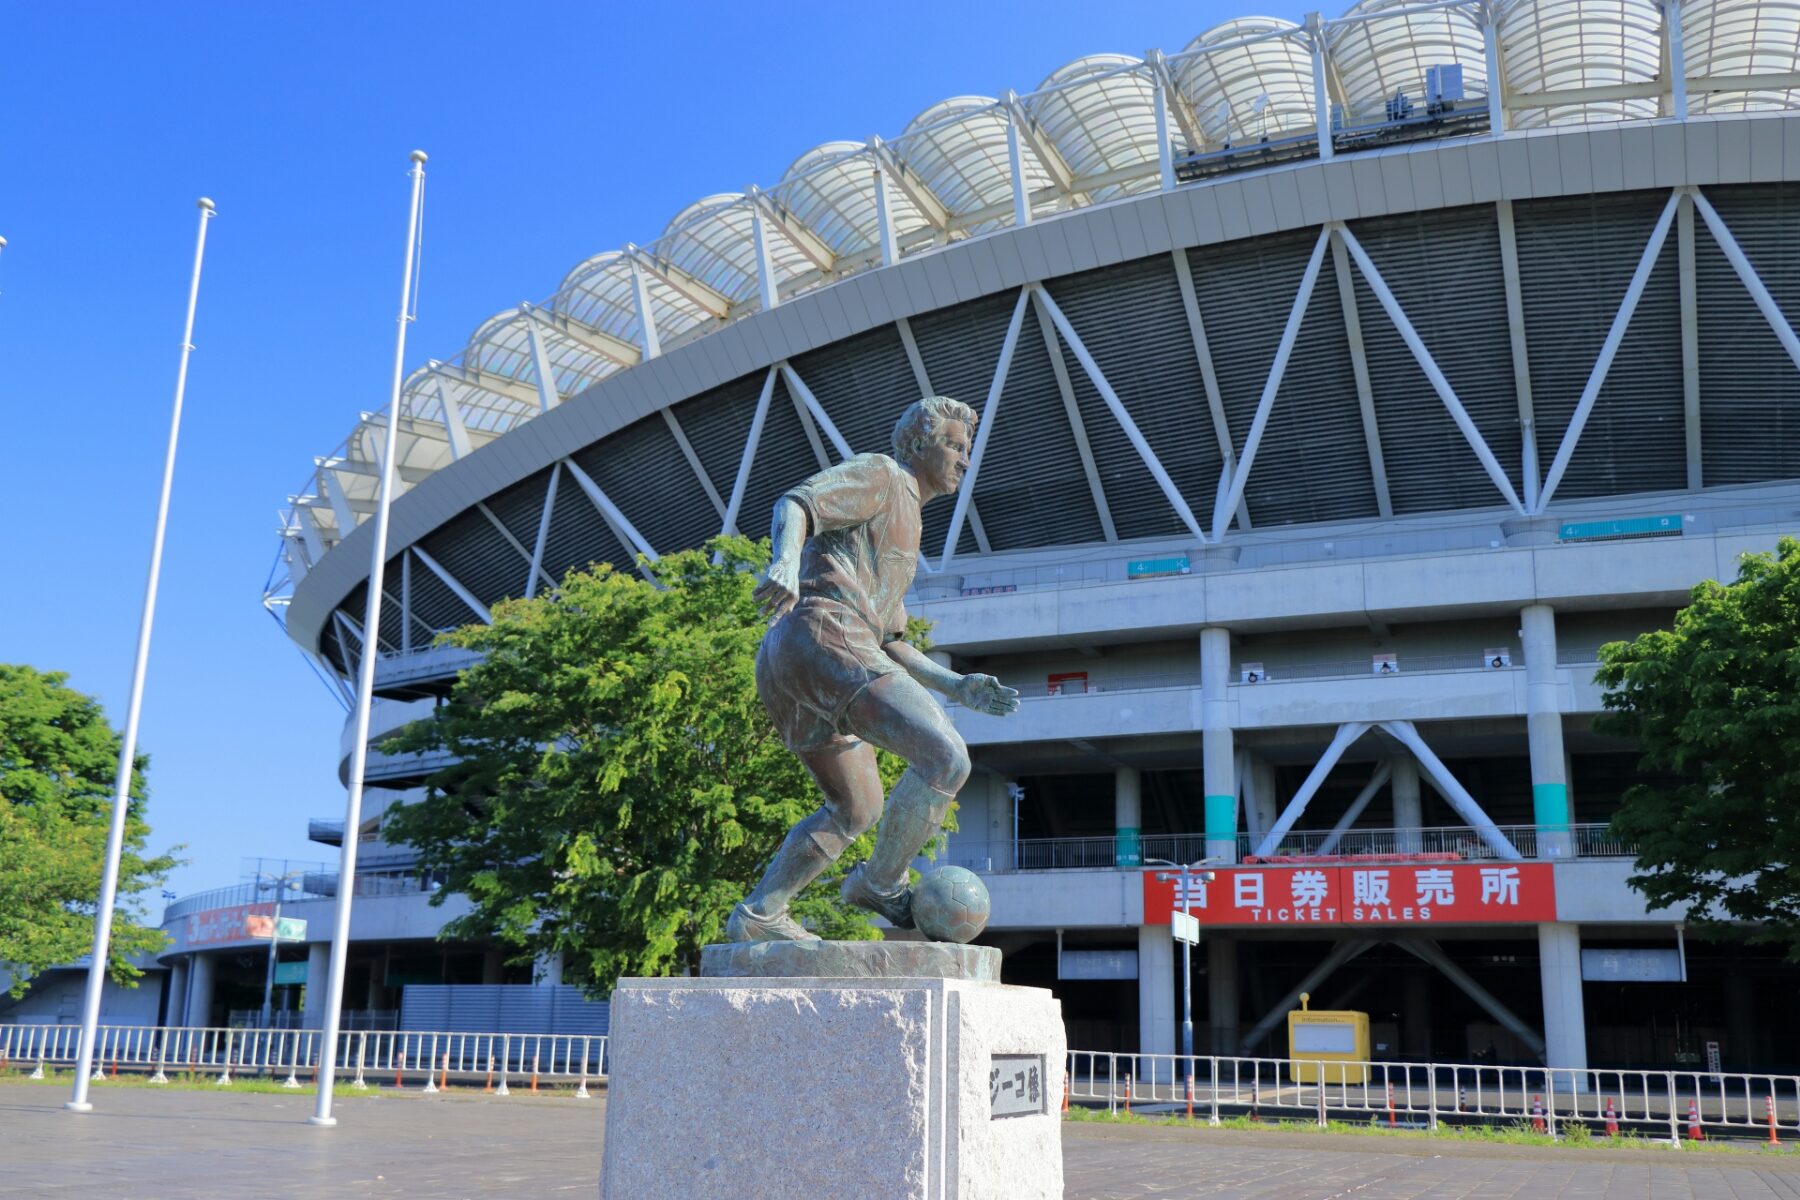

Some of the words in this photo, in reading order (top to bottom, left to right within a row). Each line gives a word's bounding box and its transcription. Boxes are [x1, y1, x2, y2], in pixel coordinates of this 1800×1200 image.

[1173, 867, 1520, 908] 当日券販売所
[1252, 908, 1336, 921] TICKET
[1353, 907, 1431, 920] SALES
